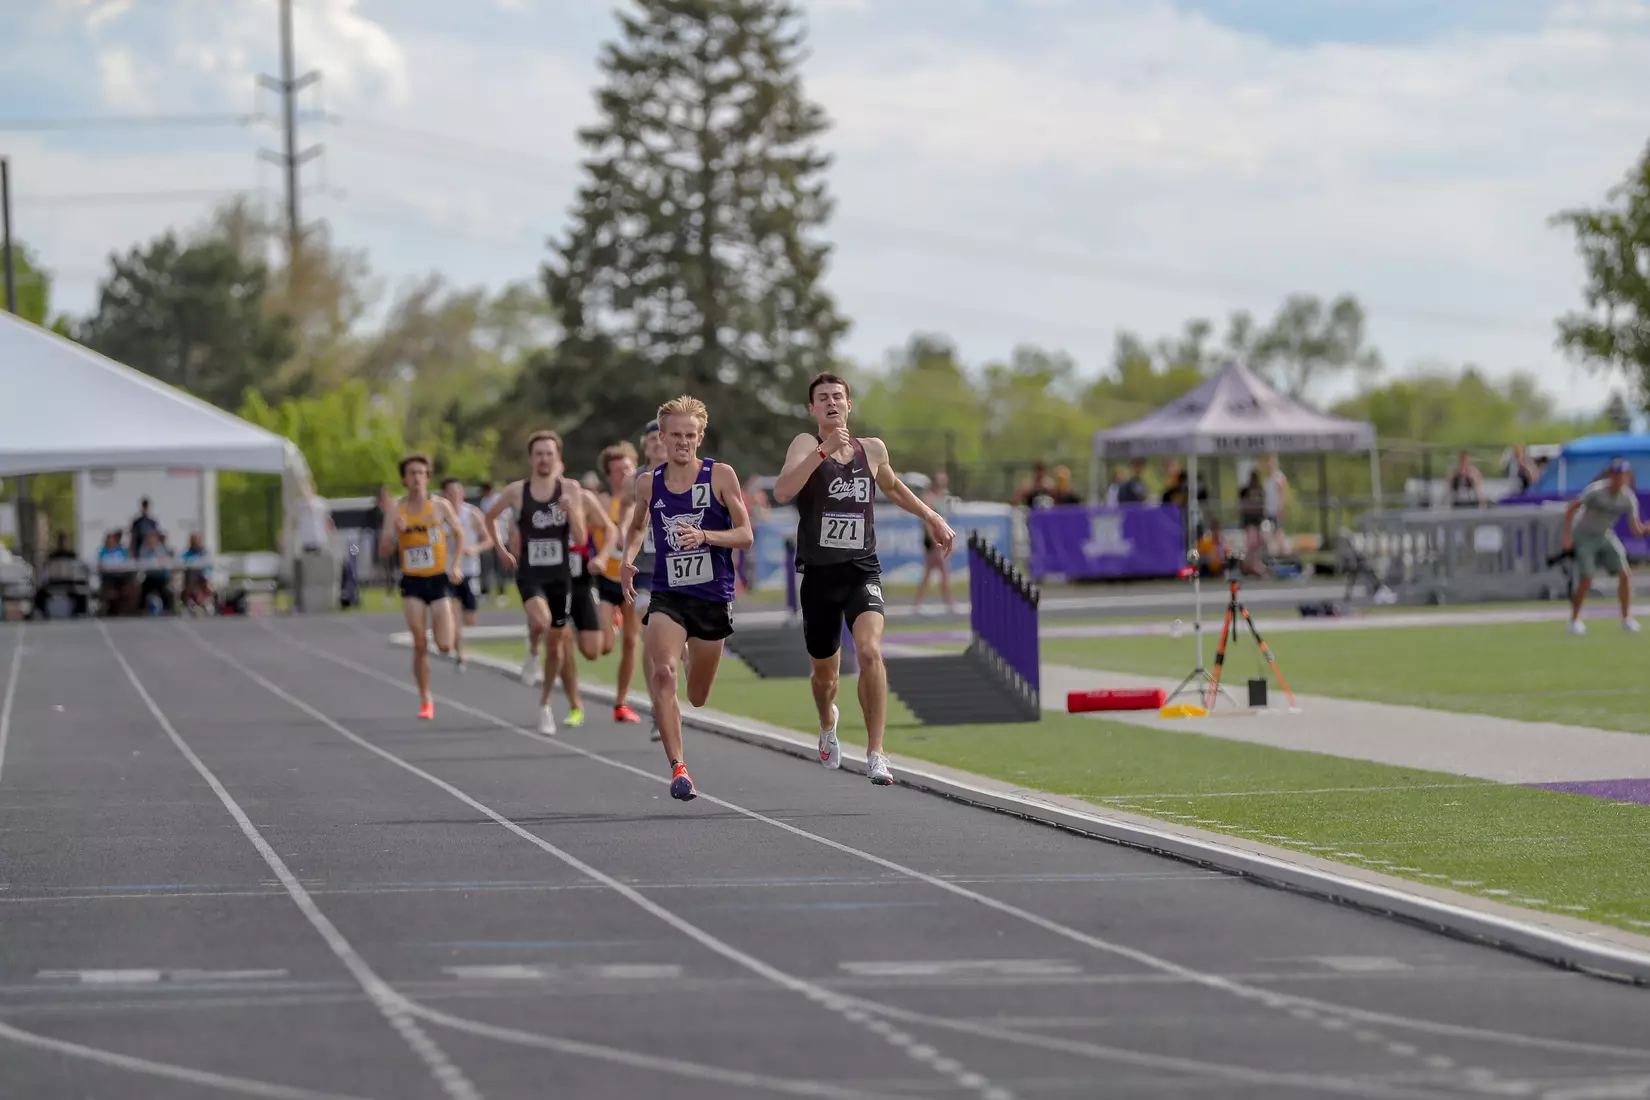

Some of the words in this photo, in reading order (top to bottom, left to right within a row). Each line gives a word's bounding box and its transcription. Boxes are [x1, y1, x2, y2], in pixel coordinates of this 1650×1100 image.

[696, 485, 707, 506] 2
[858, 479, 867, 501] 3
[827, 519, 858, 541] 271
[673, 555, 704, 578] 577
